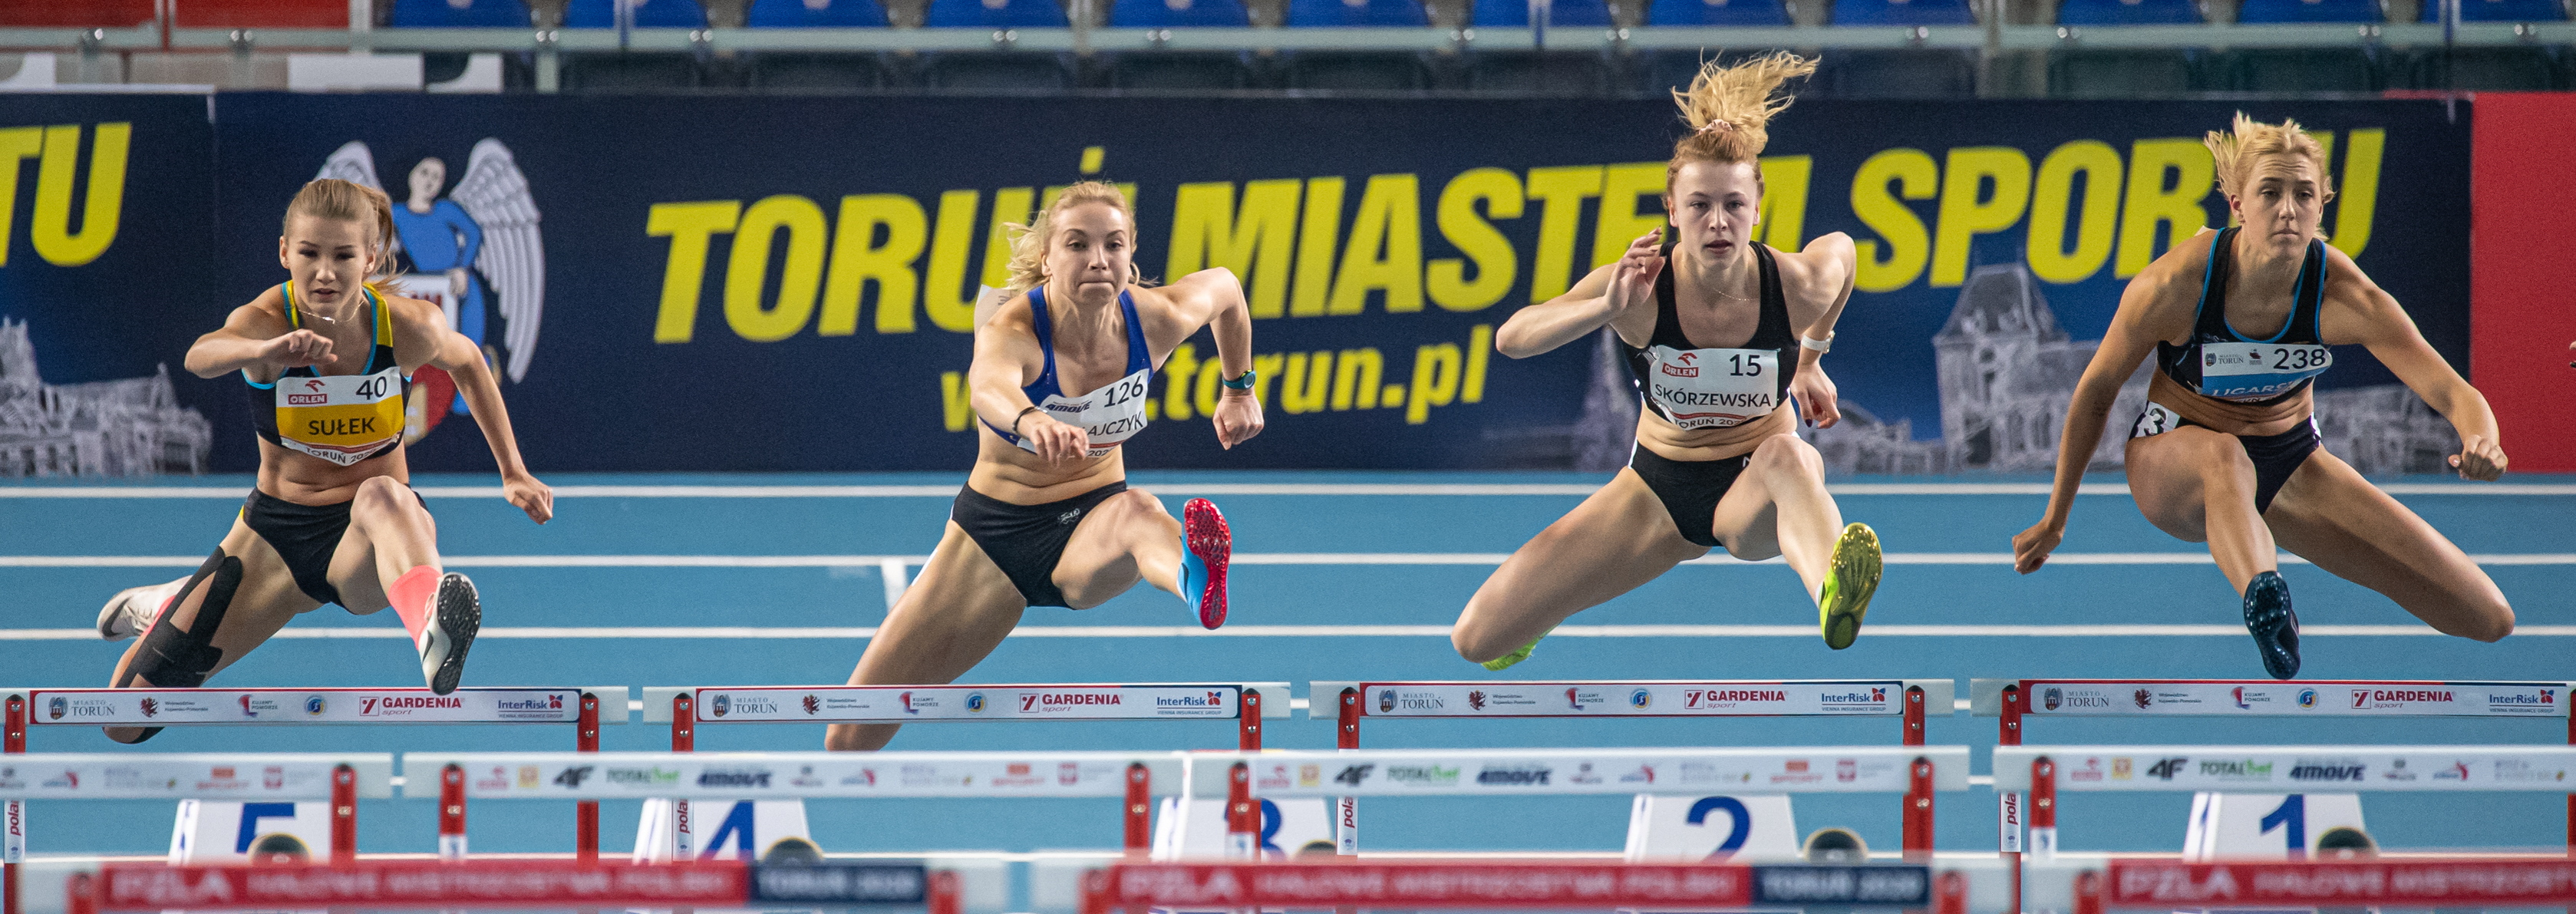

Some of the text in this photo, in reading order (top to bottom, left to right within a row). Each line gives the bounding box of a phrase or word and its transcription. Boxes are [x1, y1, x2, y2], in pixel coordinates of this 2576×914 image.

[1730, 354, 1762, 377] 15
[2274, 348, 2326, 369] 238
[1664, 365, 1697, 377] ORLEN
[356, 376, 387, 400] 40
[1104, 375, 1143, 408] 126
[289, 394, 326, 404] ORLEN
[1655, 384, 1771, 408] SKÓRZEWSKA
[308, 417, 375, 435] SUŁEK
[1083, 411, 1143, 436] AJCZYK
[1087, 449, 1113, 457] 202
[383, 697, 462, 708] GARDENIA
[1042, 694, 1121, 705] GARDENIA
[1156, 696, 1206, 706] InterRisk
[1400, 695, 1444, 709] TORUŃ
[1707, 690, 1786, 701] GARDENIA
[1822, 692, 1871, 702] InterRisk
[2066, 694, 2109, 708] TORUŃ
[2374, 690, 2453, 702] GARDENIA
[2489, 694, 2538, 704] InterRisk
[71, 703, 115, 716] TORUŃ
[498, 699, 547, 709] InterRisk
[734, 701, 778, 714] TORUŃ
[2147, 757, 2188, 780] 4F
[1341, 796, 1355, 829] pola
[2004, 792, 2019, 826] pola
[677, 799, 691, 834] pola
[694, 800, 754, 863] 4
[1687, 795, 1752, 864] 2
[2259, 794, 2306, 862] 1
